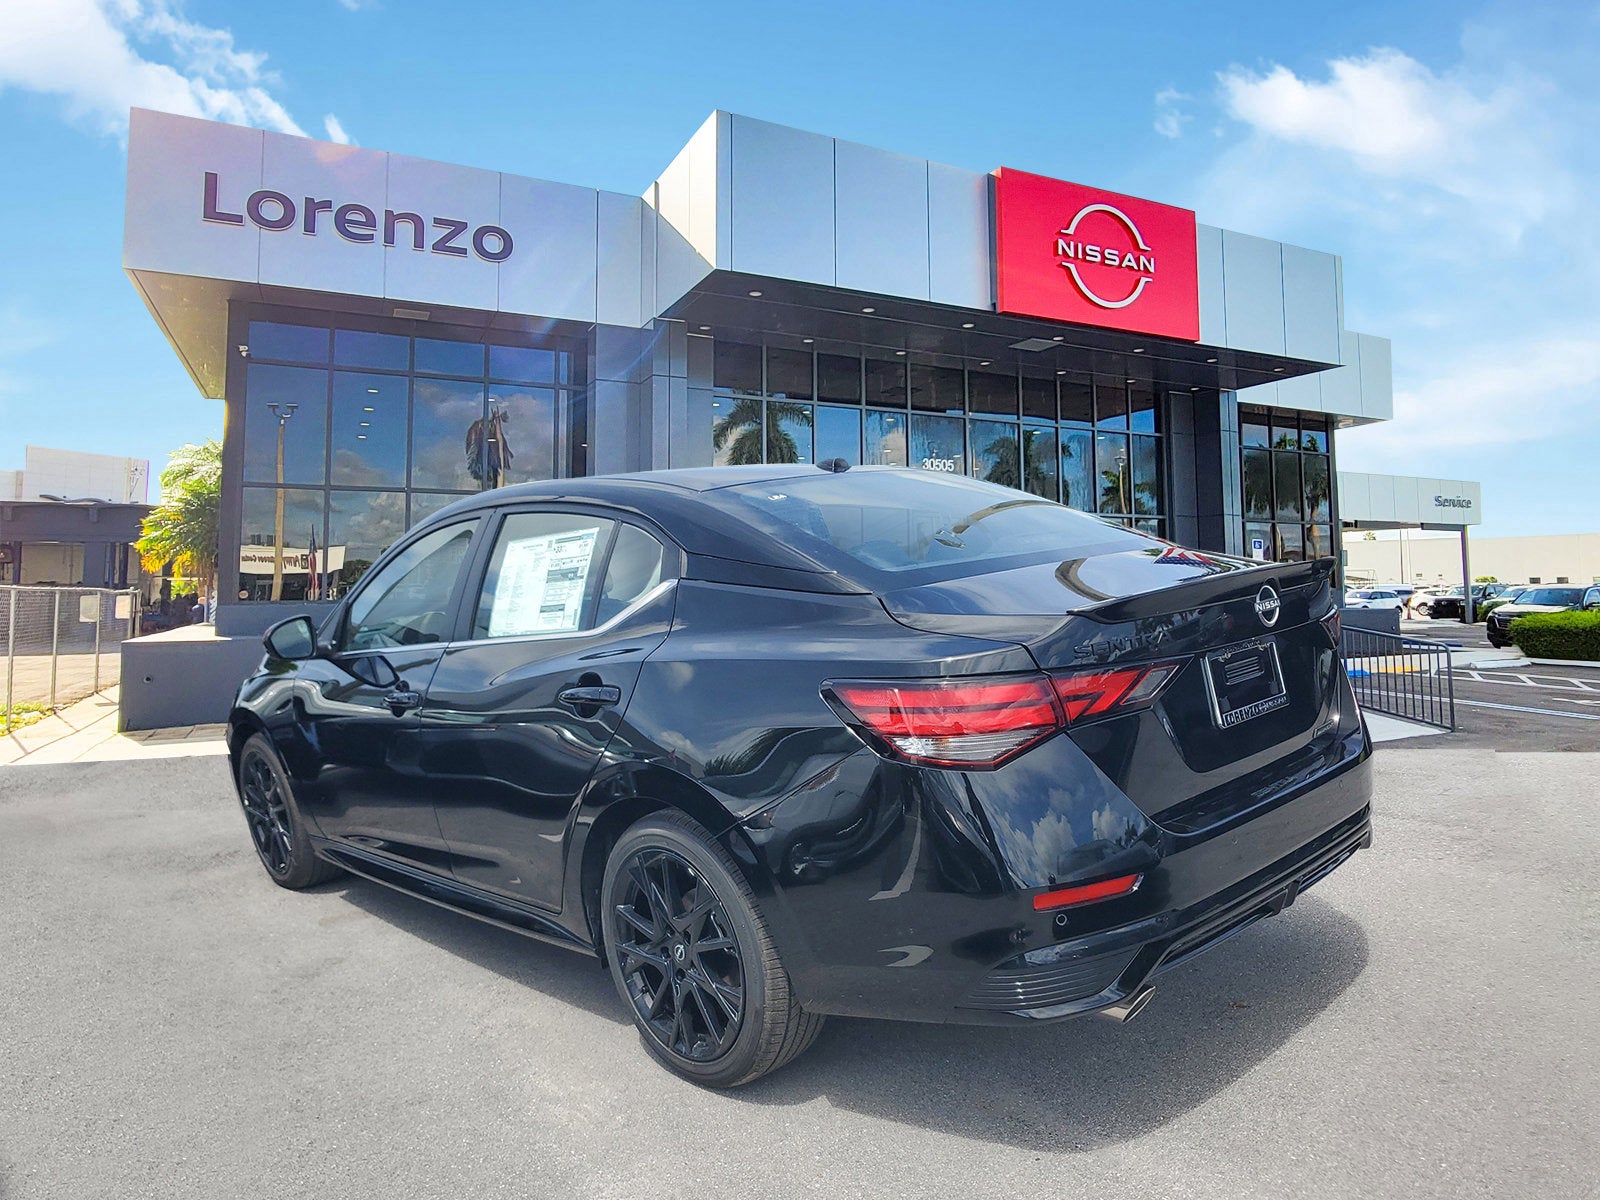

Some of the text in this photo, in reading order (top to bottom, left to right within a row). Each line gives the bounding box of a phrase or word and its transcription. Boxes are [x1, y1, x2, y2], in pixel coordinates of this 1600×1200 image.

[202, 171, 514, 263] Lorenzo
[1057, 238, 1155, 273] NISSAN
[922, 457, 955, 472] 30505
[1434, 495, 1472, 509] Service
[1073, 629, 1171, 660] SENTRA
